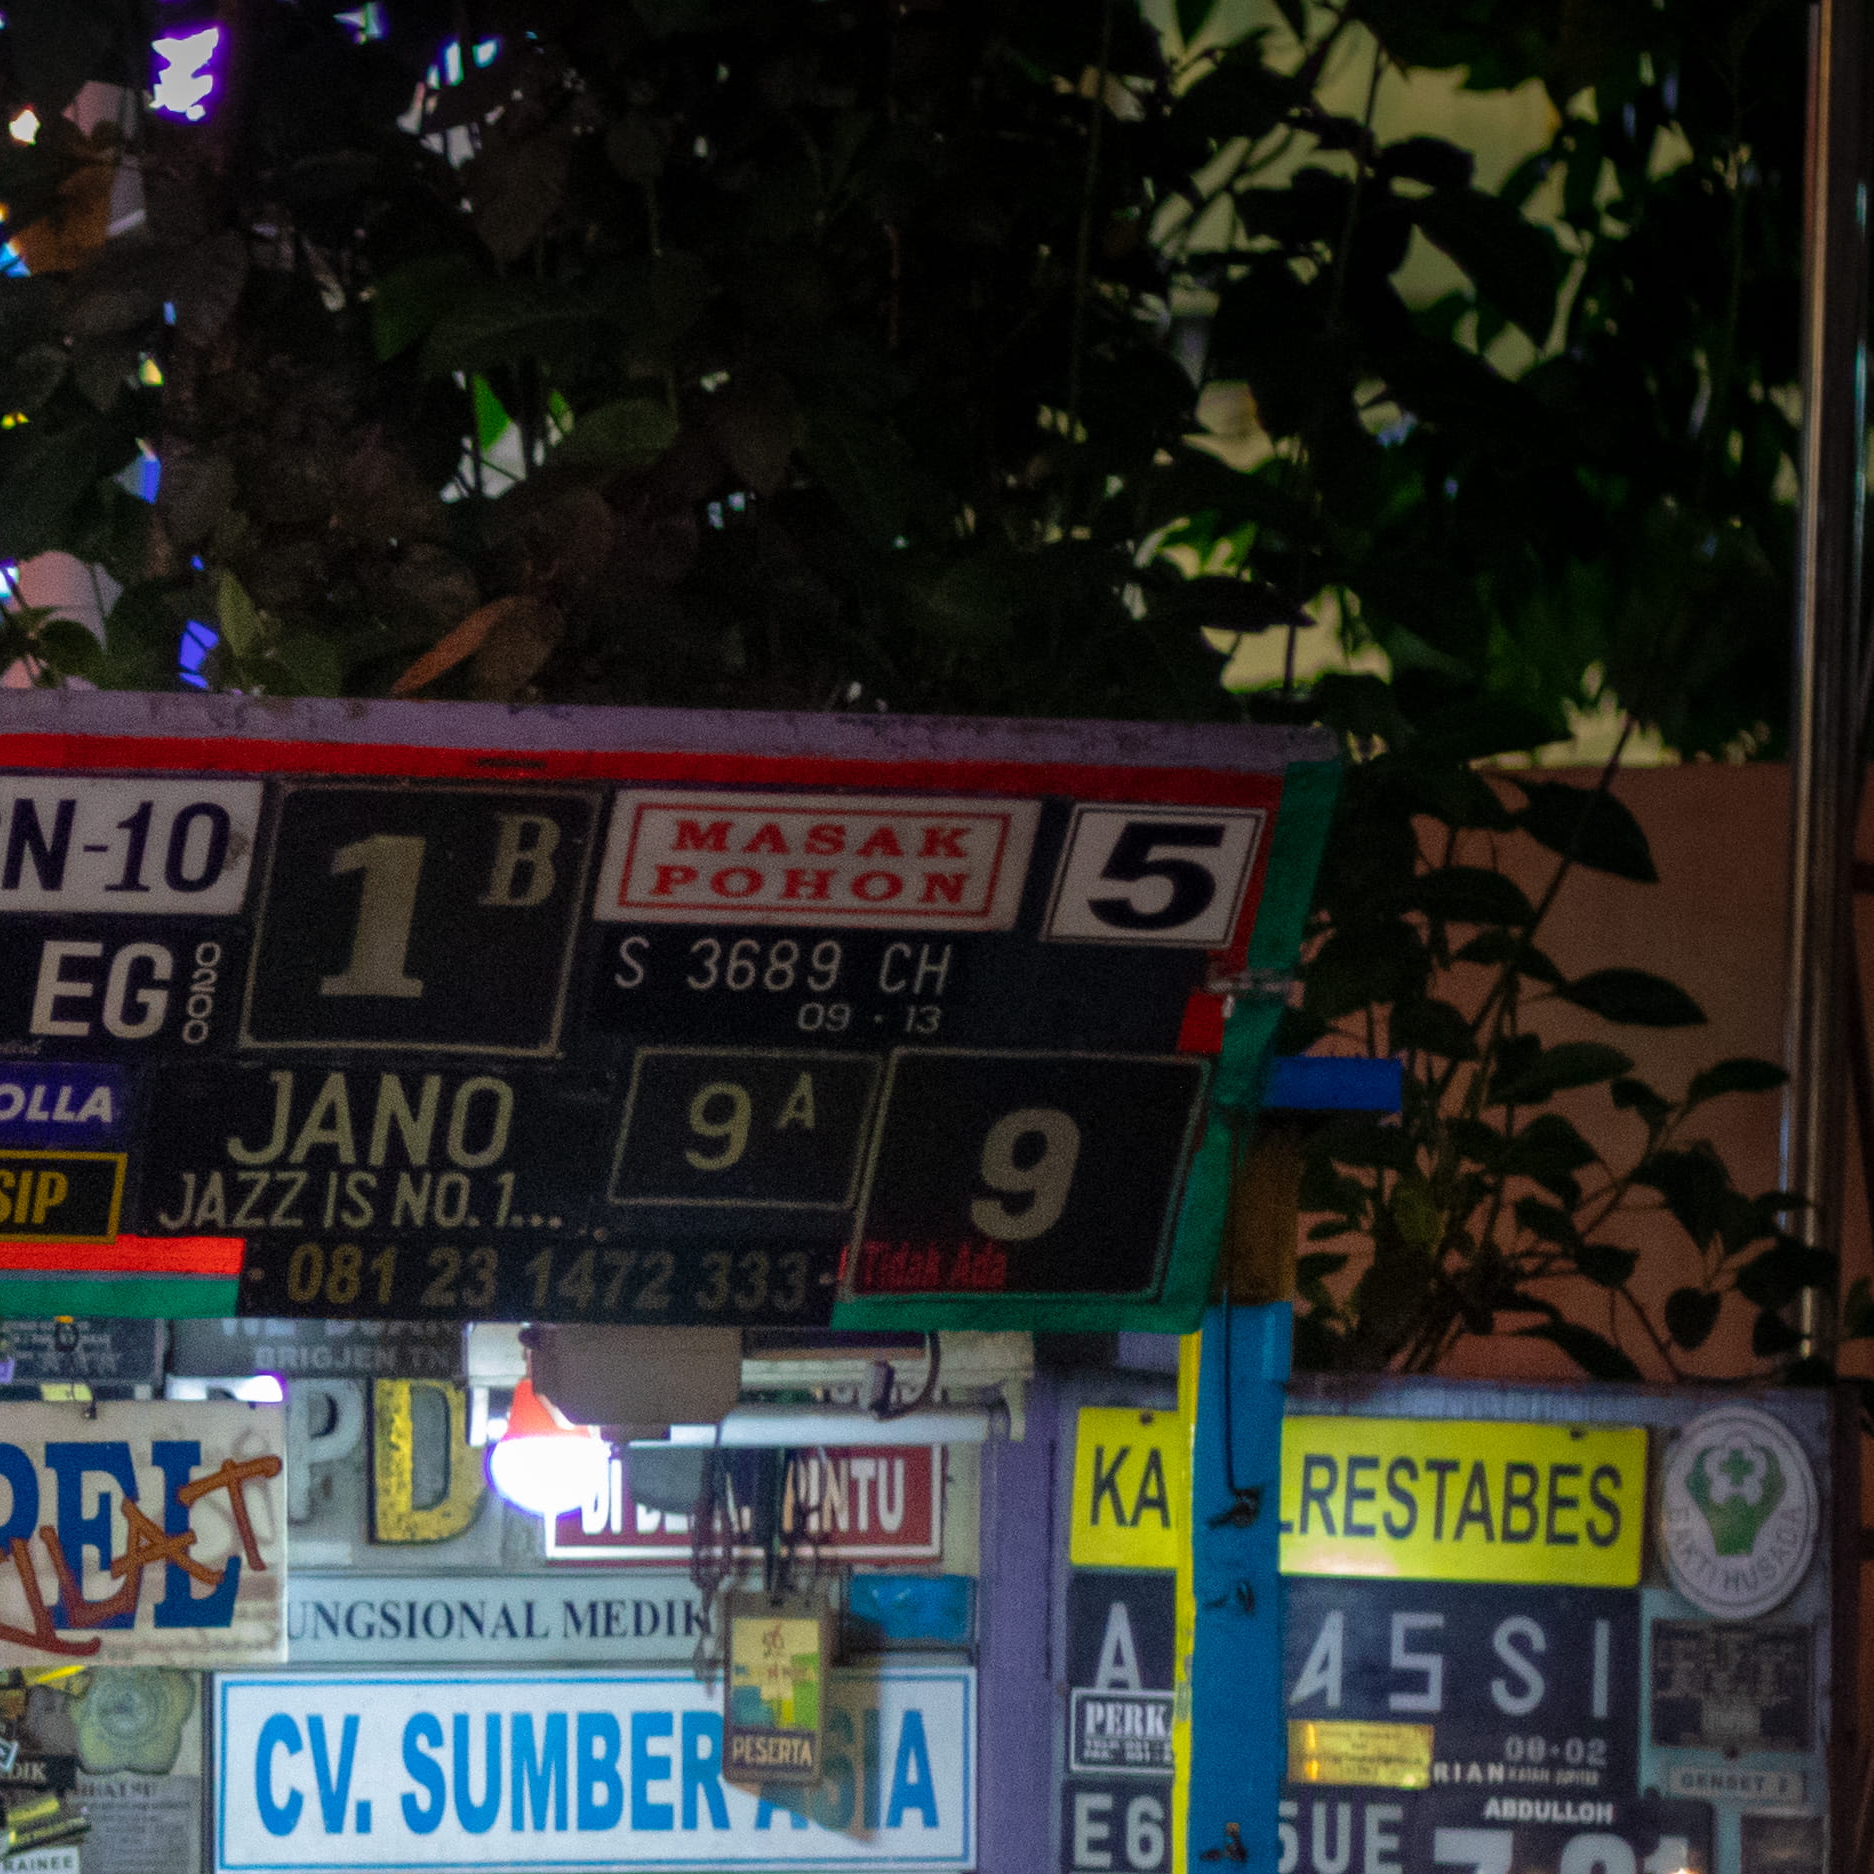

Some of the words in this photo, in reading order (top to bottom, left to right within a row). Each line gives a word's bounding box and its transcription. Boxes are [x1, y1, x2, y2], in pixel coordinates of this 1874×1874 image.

[671, 818, 974, 860] MASAK
[317, 833, 428, 999] 1
[478, 811, 561, 907] B
[649, 864, 971, 906] POHON
[1086, 821, 1228, 931] 5
[28, 938, 176, 1041] EG
[613, 935, 652, 991] S
[686, 937, 842, 994] 3689
[877, 941, 953, 996] CH
[797, 1003, 851, 1033] 09
[903, 1004, 942, 1034] 13
[225, 1069, 515, 1169] JANO
[684, 1083, 754, 1171] 9
[775, 1072, 818, 1130] A
[158, 1171, 310, 1230] JAZZ
[322, 1171, 379, 1230] IS
[969, 1104, 1083, 1241] 9
[287, 1243, 399, 1304] 081
[420, 1245, 501, 1307] 23
[523, 1248, 675, 1311] 1472
[697, 1250, 809, 1312] 333
[254, 1345, 398, 1370] BRIGJEN
[1278, 1453, 1625, 1549] RESTABES
[1093, 1602, 1144, 1691] A
[254, 1711, 373, 1838] CV.
[401, 1709, 732, 1836] SUMBER
[732, 1734, 814, 1768] PESERTA
[1680, 1770, 1765, 1794] GENSET
[1483, 1796, 1615, 1826] ABDULLOH
